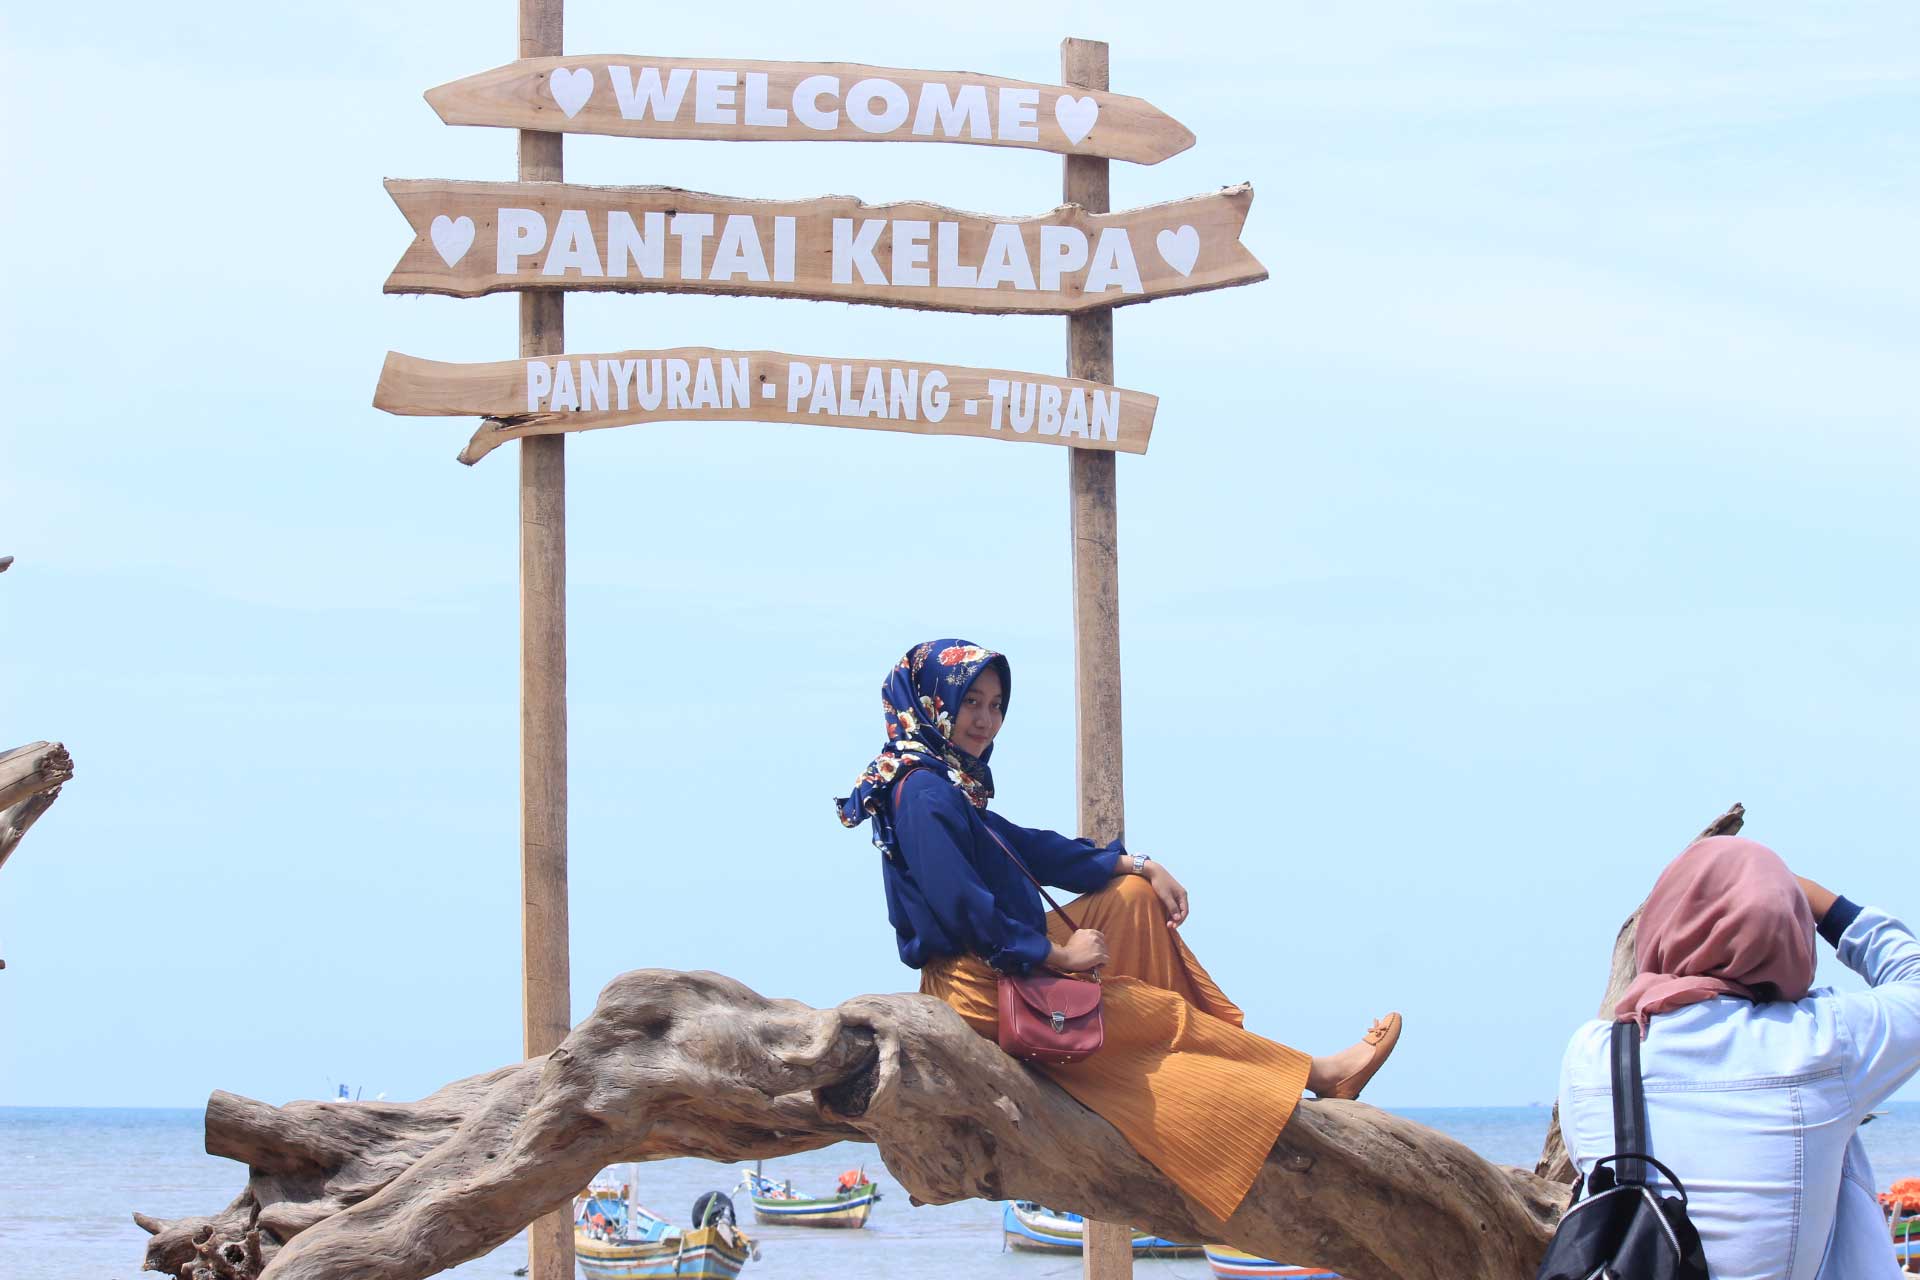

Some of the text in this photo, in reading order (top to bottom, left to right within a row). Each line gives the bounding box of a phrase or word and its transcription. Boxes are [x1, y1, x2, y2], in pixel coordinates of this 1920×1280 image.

[607, 65, 1040, 143] WELCOME
[496, 208, 1144, 294] PANTAI KELAPA
[526, 358, 751, 412] PANYURAN
[787, 362, 950, 423] PALANG
[987, 379, 1121, 442] TUBAN
